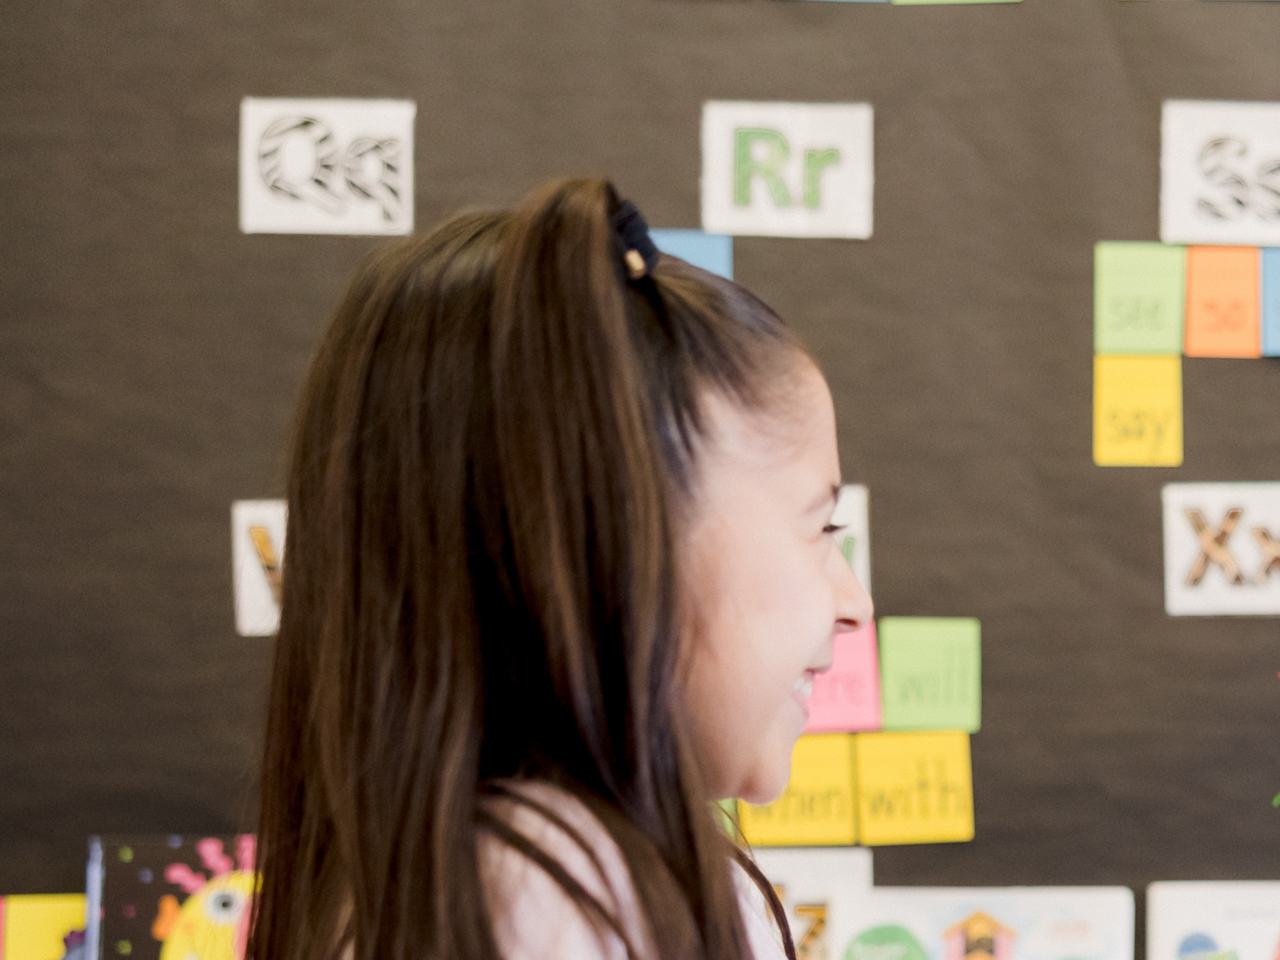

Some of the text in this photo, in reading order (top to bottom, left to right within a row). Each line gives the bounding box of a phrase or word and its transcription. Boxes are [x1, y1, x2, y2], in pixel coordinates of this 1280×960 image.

[732, 126, 840, 208] Rr
[1199, 298, 1250, 334] so
[863, 756, 965, 818] with
